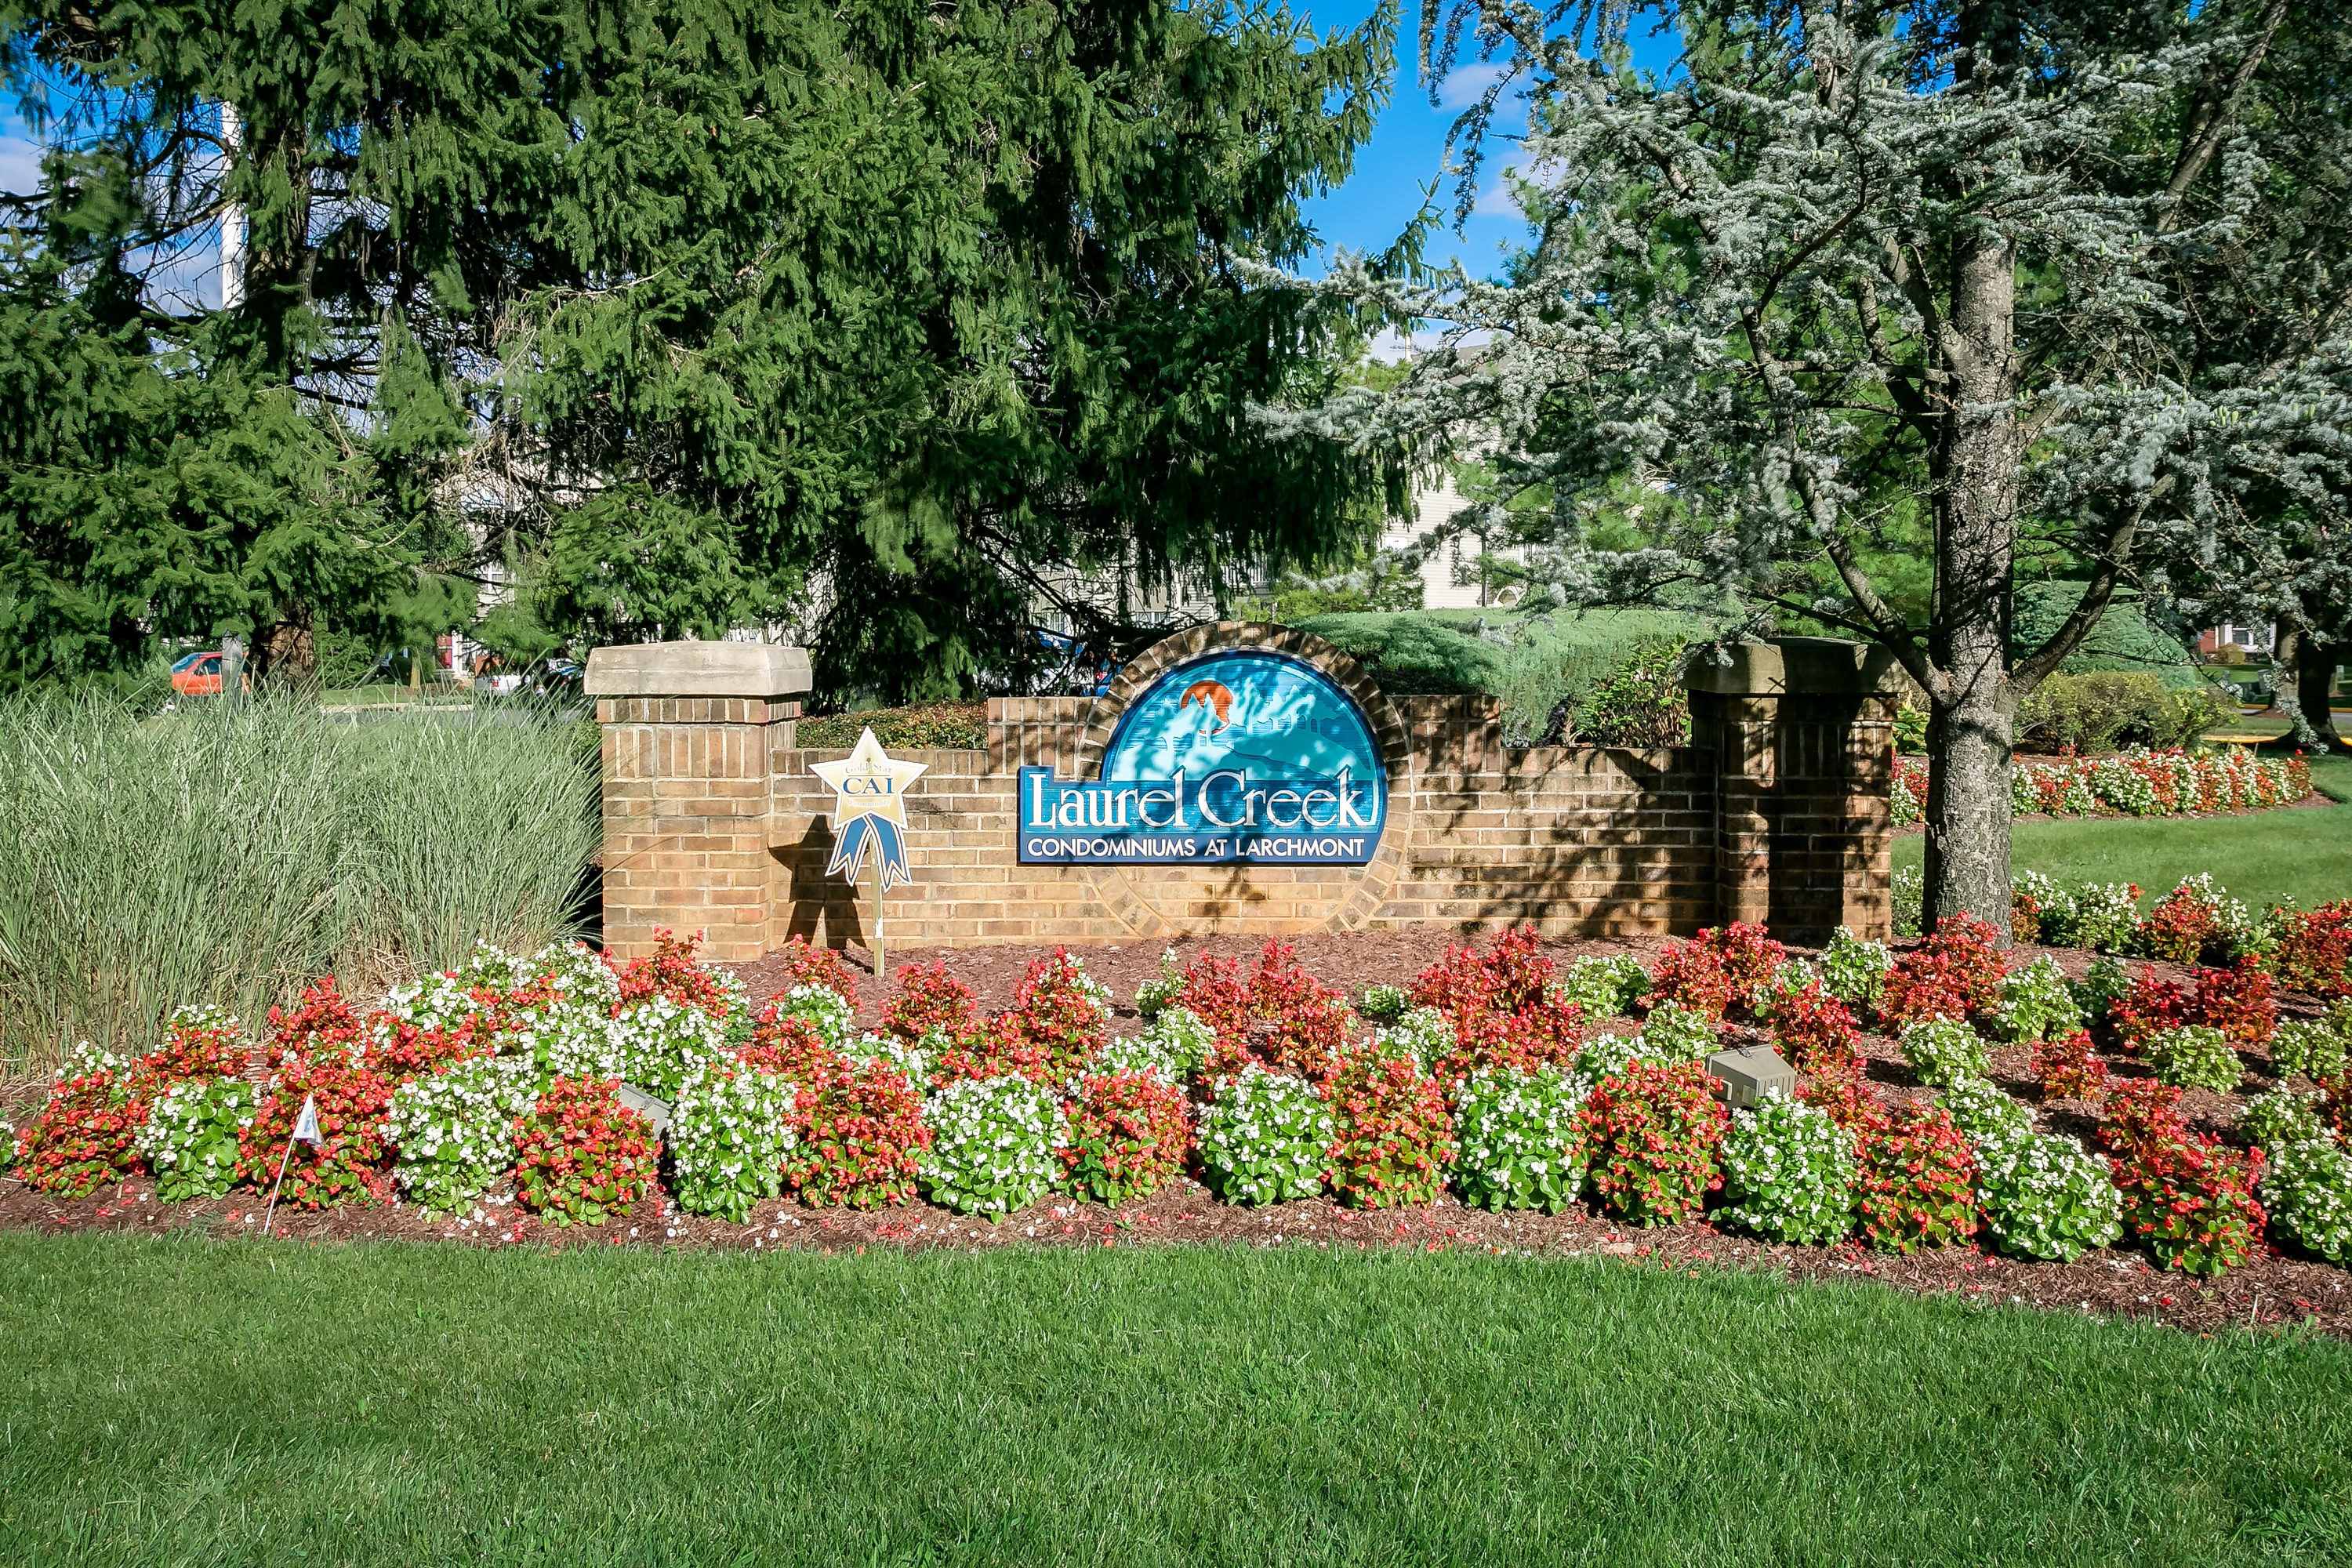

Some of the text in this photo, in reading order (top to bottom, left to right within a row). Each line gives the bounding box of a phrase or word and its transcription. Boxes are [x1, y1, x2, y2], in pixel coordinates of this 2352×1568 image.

[845, 762, 891, 774] Gold Star
[843, 777, 895, 794] CAI
[1028, 768, 1375, 829] Laurel Creek
[1027, 837, 1365, 857] CONDOMINIUMS AT LARCHMONT
